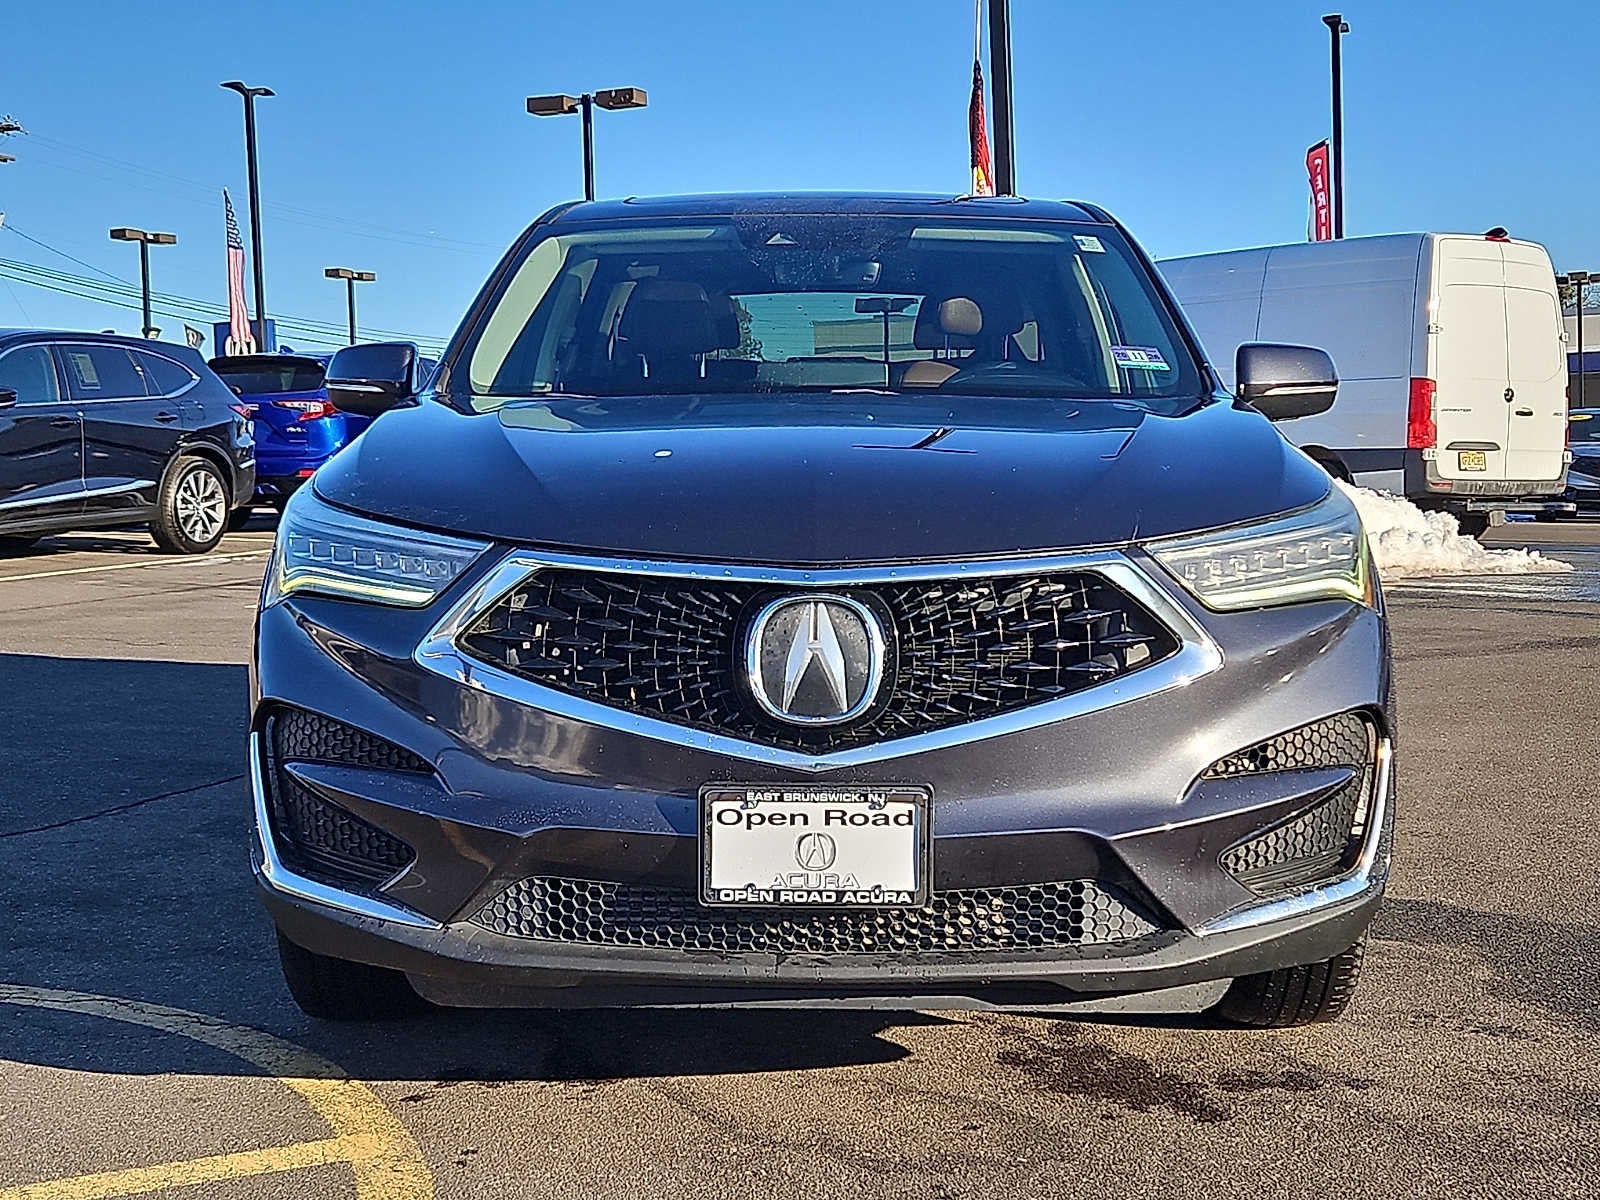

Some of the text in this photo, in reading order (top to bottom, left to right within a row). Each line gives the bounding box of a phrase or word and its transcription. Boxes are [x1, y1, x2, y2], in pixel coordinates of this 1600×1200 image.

[1131, 352, 1146, 360] 11
[746, 792, 780, 802] EAST
[868, 793, 885, 803] NJ
[716, 808, 914, 831] Open Road
[769, 872, 860, 888] ACURA
[719, 889, 912, 904] OPEN ROAD ACURA
